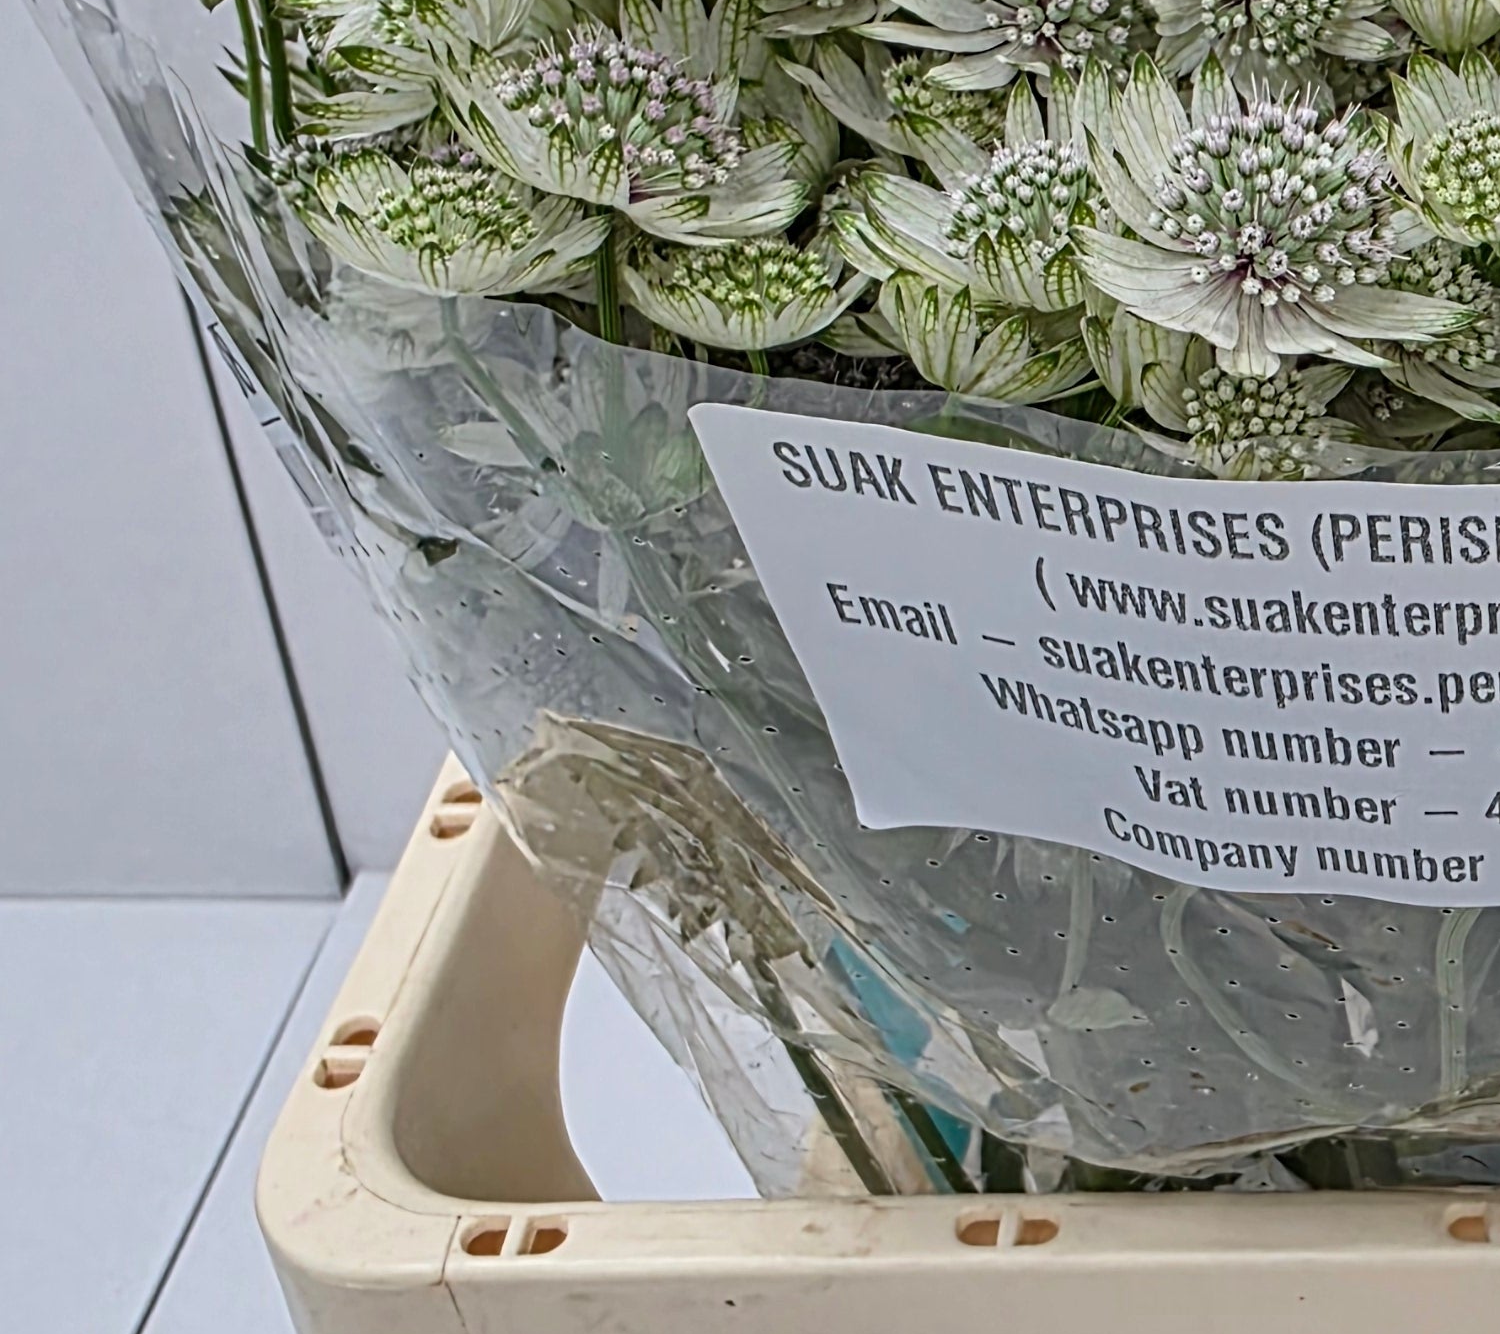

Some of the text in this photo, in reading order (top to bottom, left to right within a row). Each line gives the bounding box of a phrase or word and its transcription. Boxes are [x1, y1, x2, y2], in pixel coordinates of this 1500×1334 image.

[772, 441, 917, 505] SUAK
[927, 464, 1290, 561] ENTERPRISES
[827, 582, 958, 645] Email
[1034, 556, 1055, 610] (
[979, 672, 1203, 759] Whatsapp
[1222, 727, 1400, 769] number
[1134, 766, 1208, 810] Vat
[1225, 786, 1397, 826] number
[1104, 808, 1297, 877] Company
[1318, 847, 1485, 883] number
